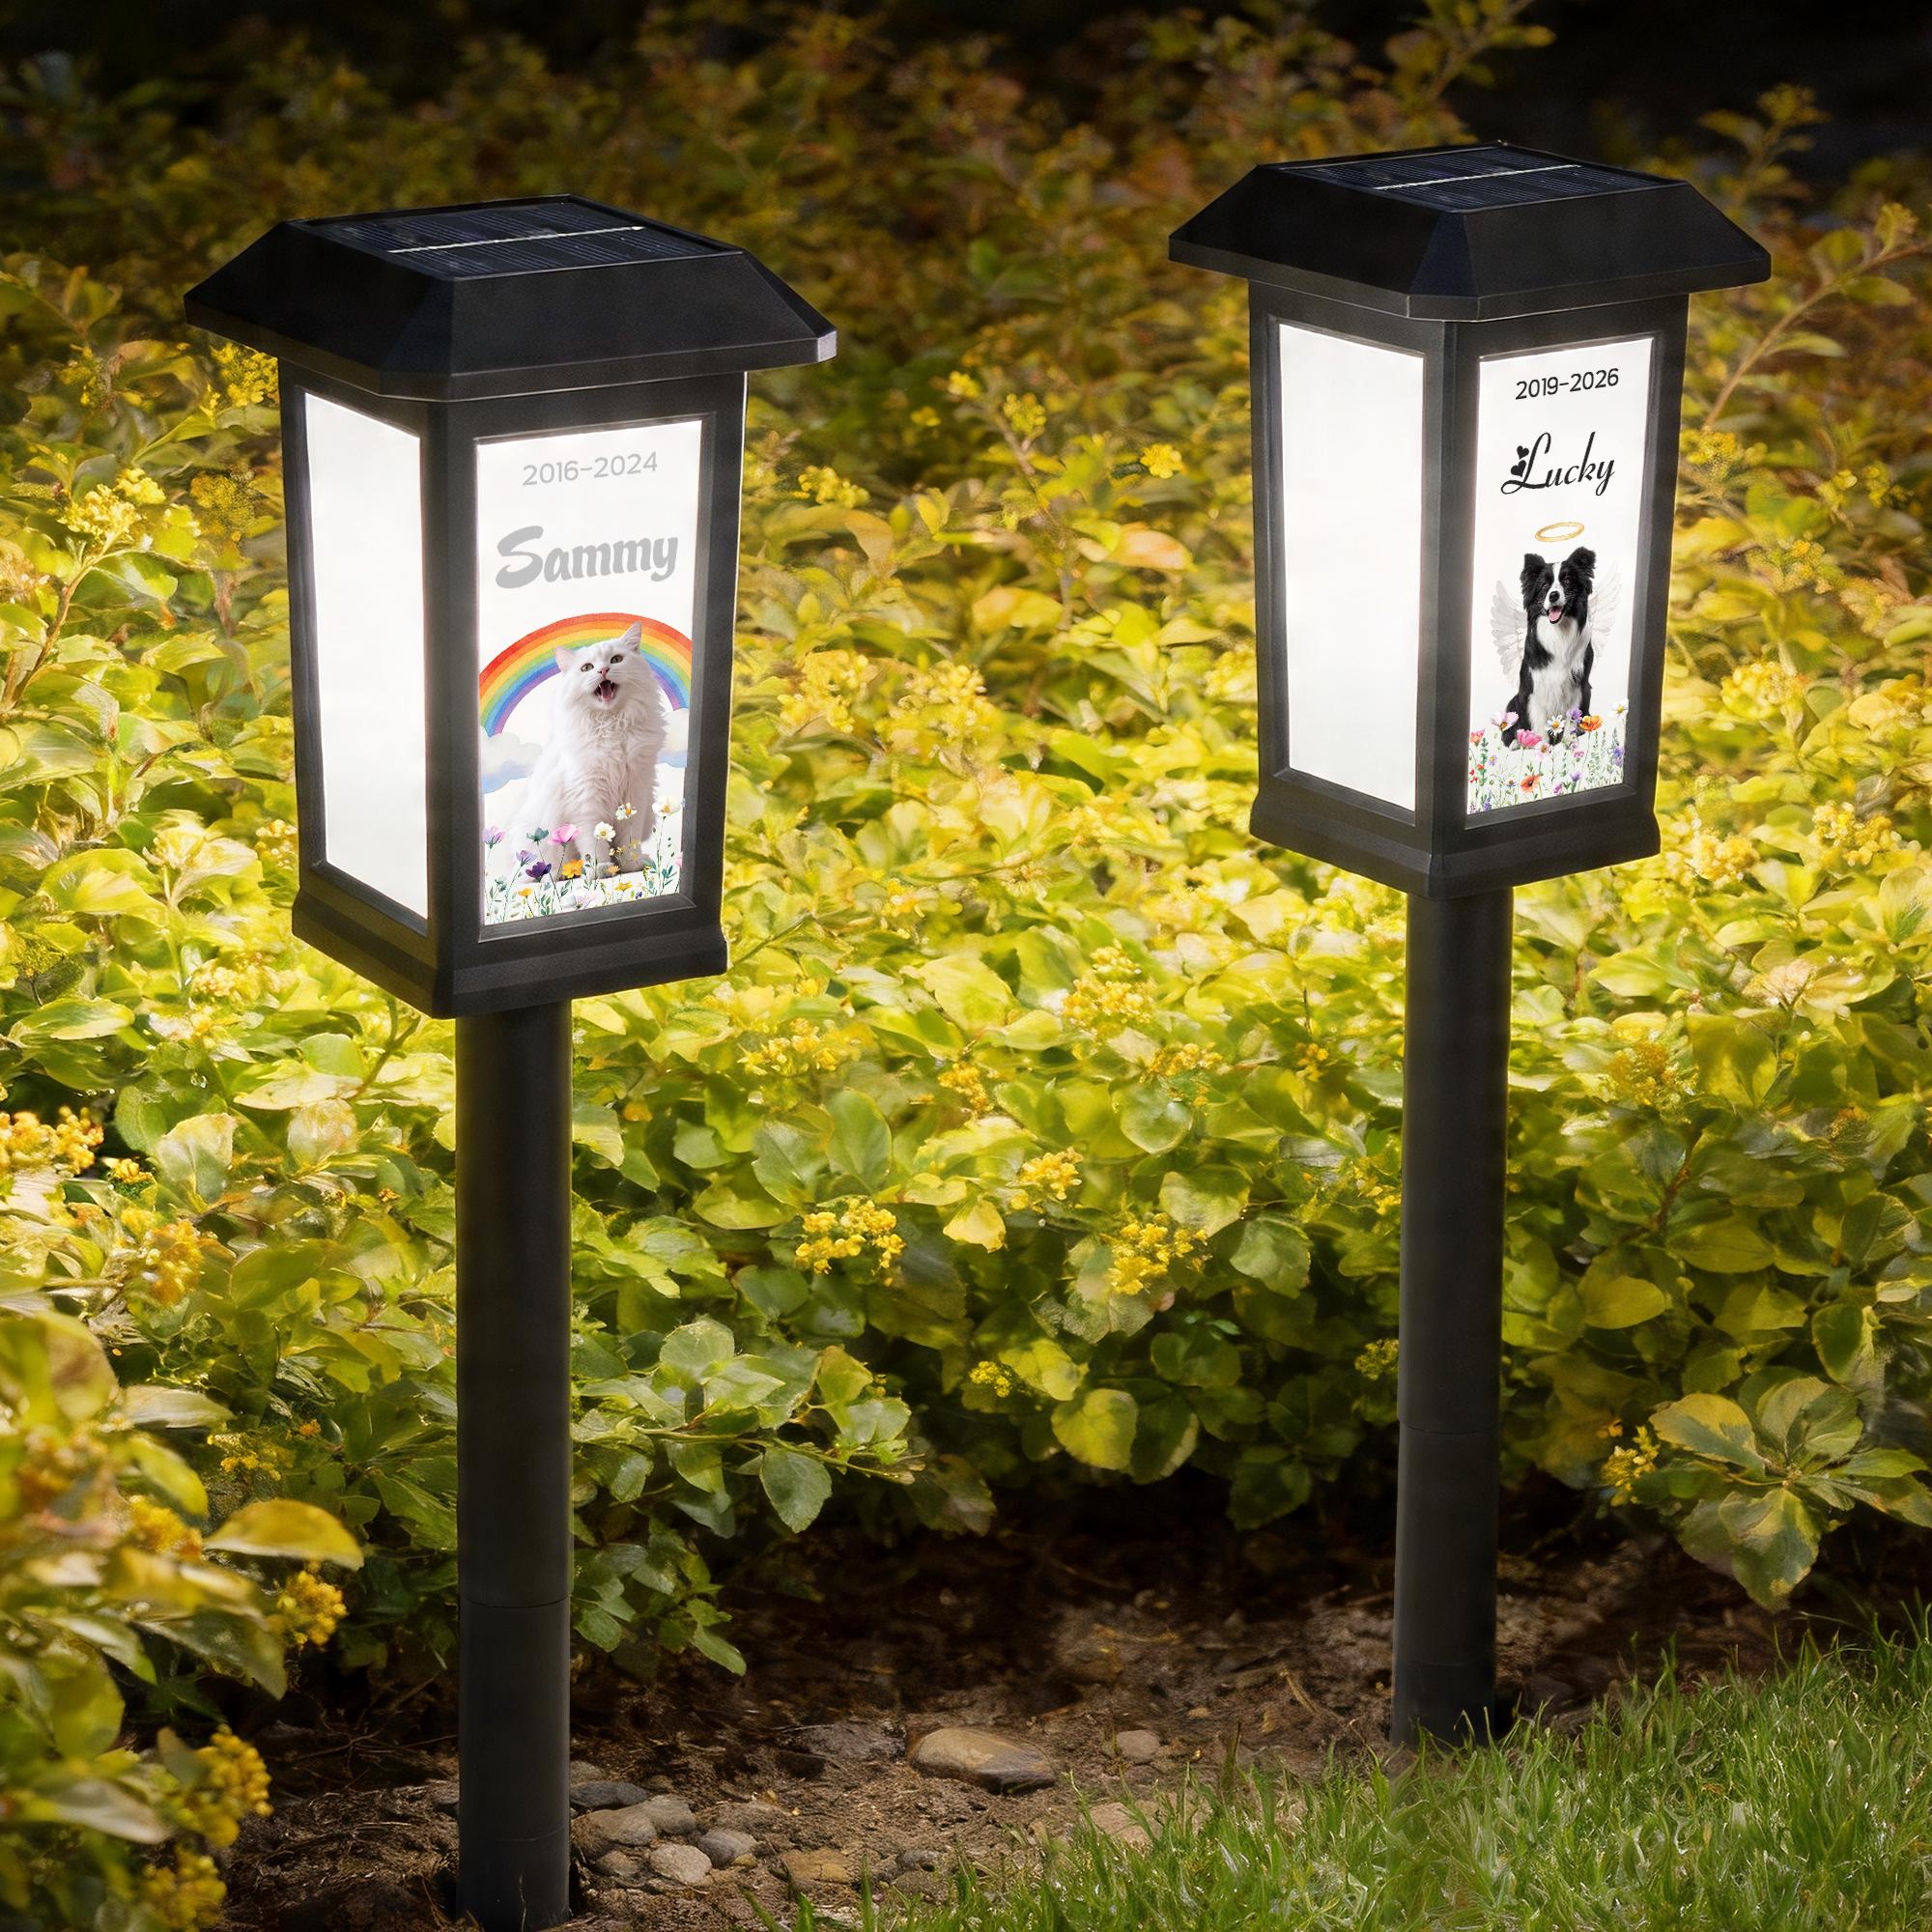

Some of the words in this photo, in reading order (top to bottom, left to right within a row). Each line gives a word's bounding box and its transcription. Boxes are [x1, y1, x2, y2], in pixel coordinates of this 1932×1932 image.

[1516, 367, 1620, 400] 2019-2026
[523, 452, 658, 486] 2016-2024
[1501, 432, 1615, 496] Lucky
[496, 526, 678, 588] Sammy
